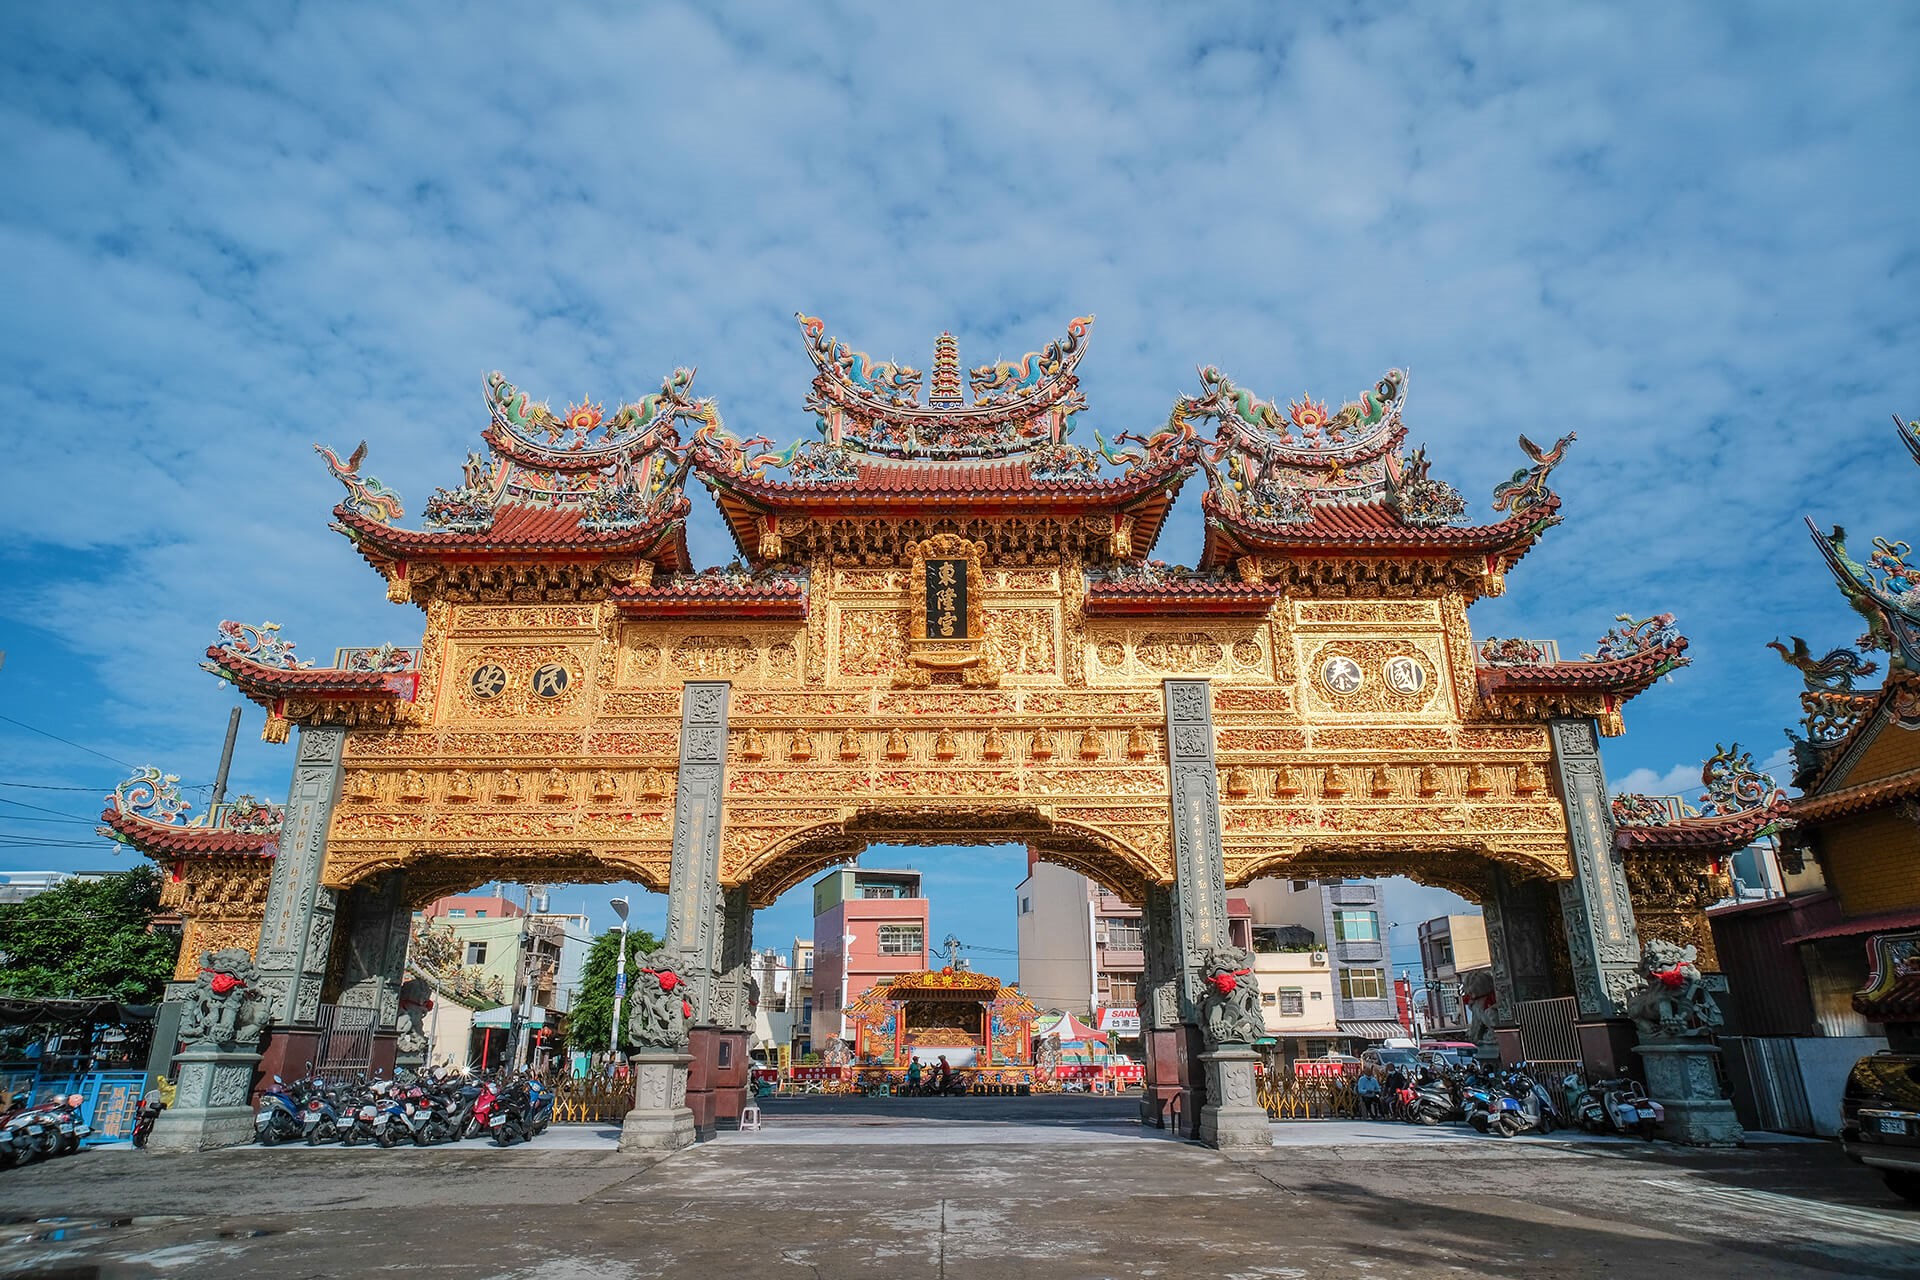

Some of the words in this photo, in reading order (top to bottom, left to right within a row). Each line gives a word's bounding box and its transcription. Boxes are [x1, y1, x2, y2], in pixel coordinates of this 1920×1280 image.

[935, 561, 958, 637] 東隆宮
[1111, 1019, 1140, 1028] 台灣三
